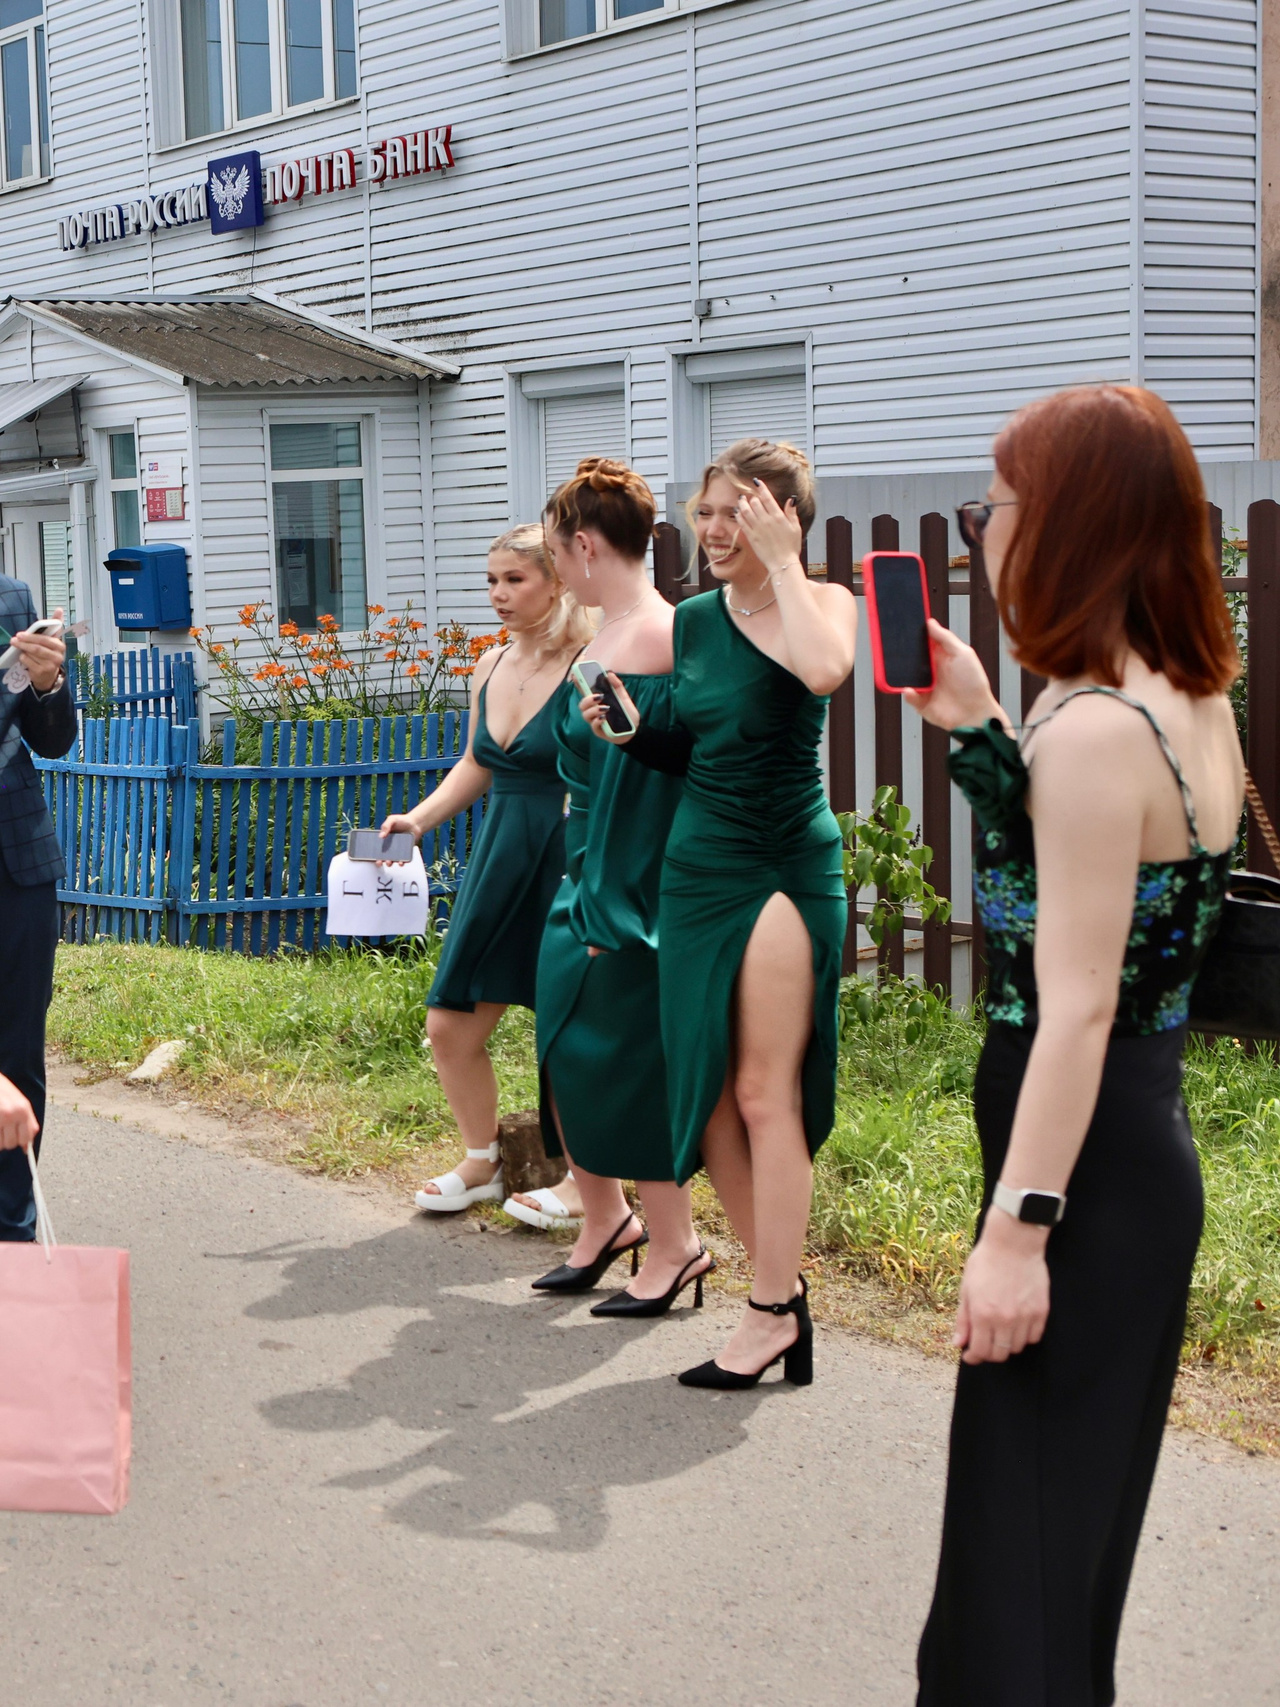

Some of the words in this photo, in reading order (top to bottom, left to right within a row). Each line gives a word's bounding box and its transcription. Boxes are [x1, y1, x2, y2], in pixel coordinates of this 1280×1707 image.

[266, 149, 356, 204] ПОЧТА
[368, 125, 454, 183] БАНК
[57, 204, 125, 250] ПОЧТА
[129, 184, 209, 235] РОССИИ
